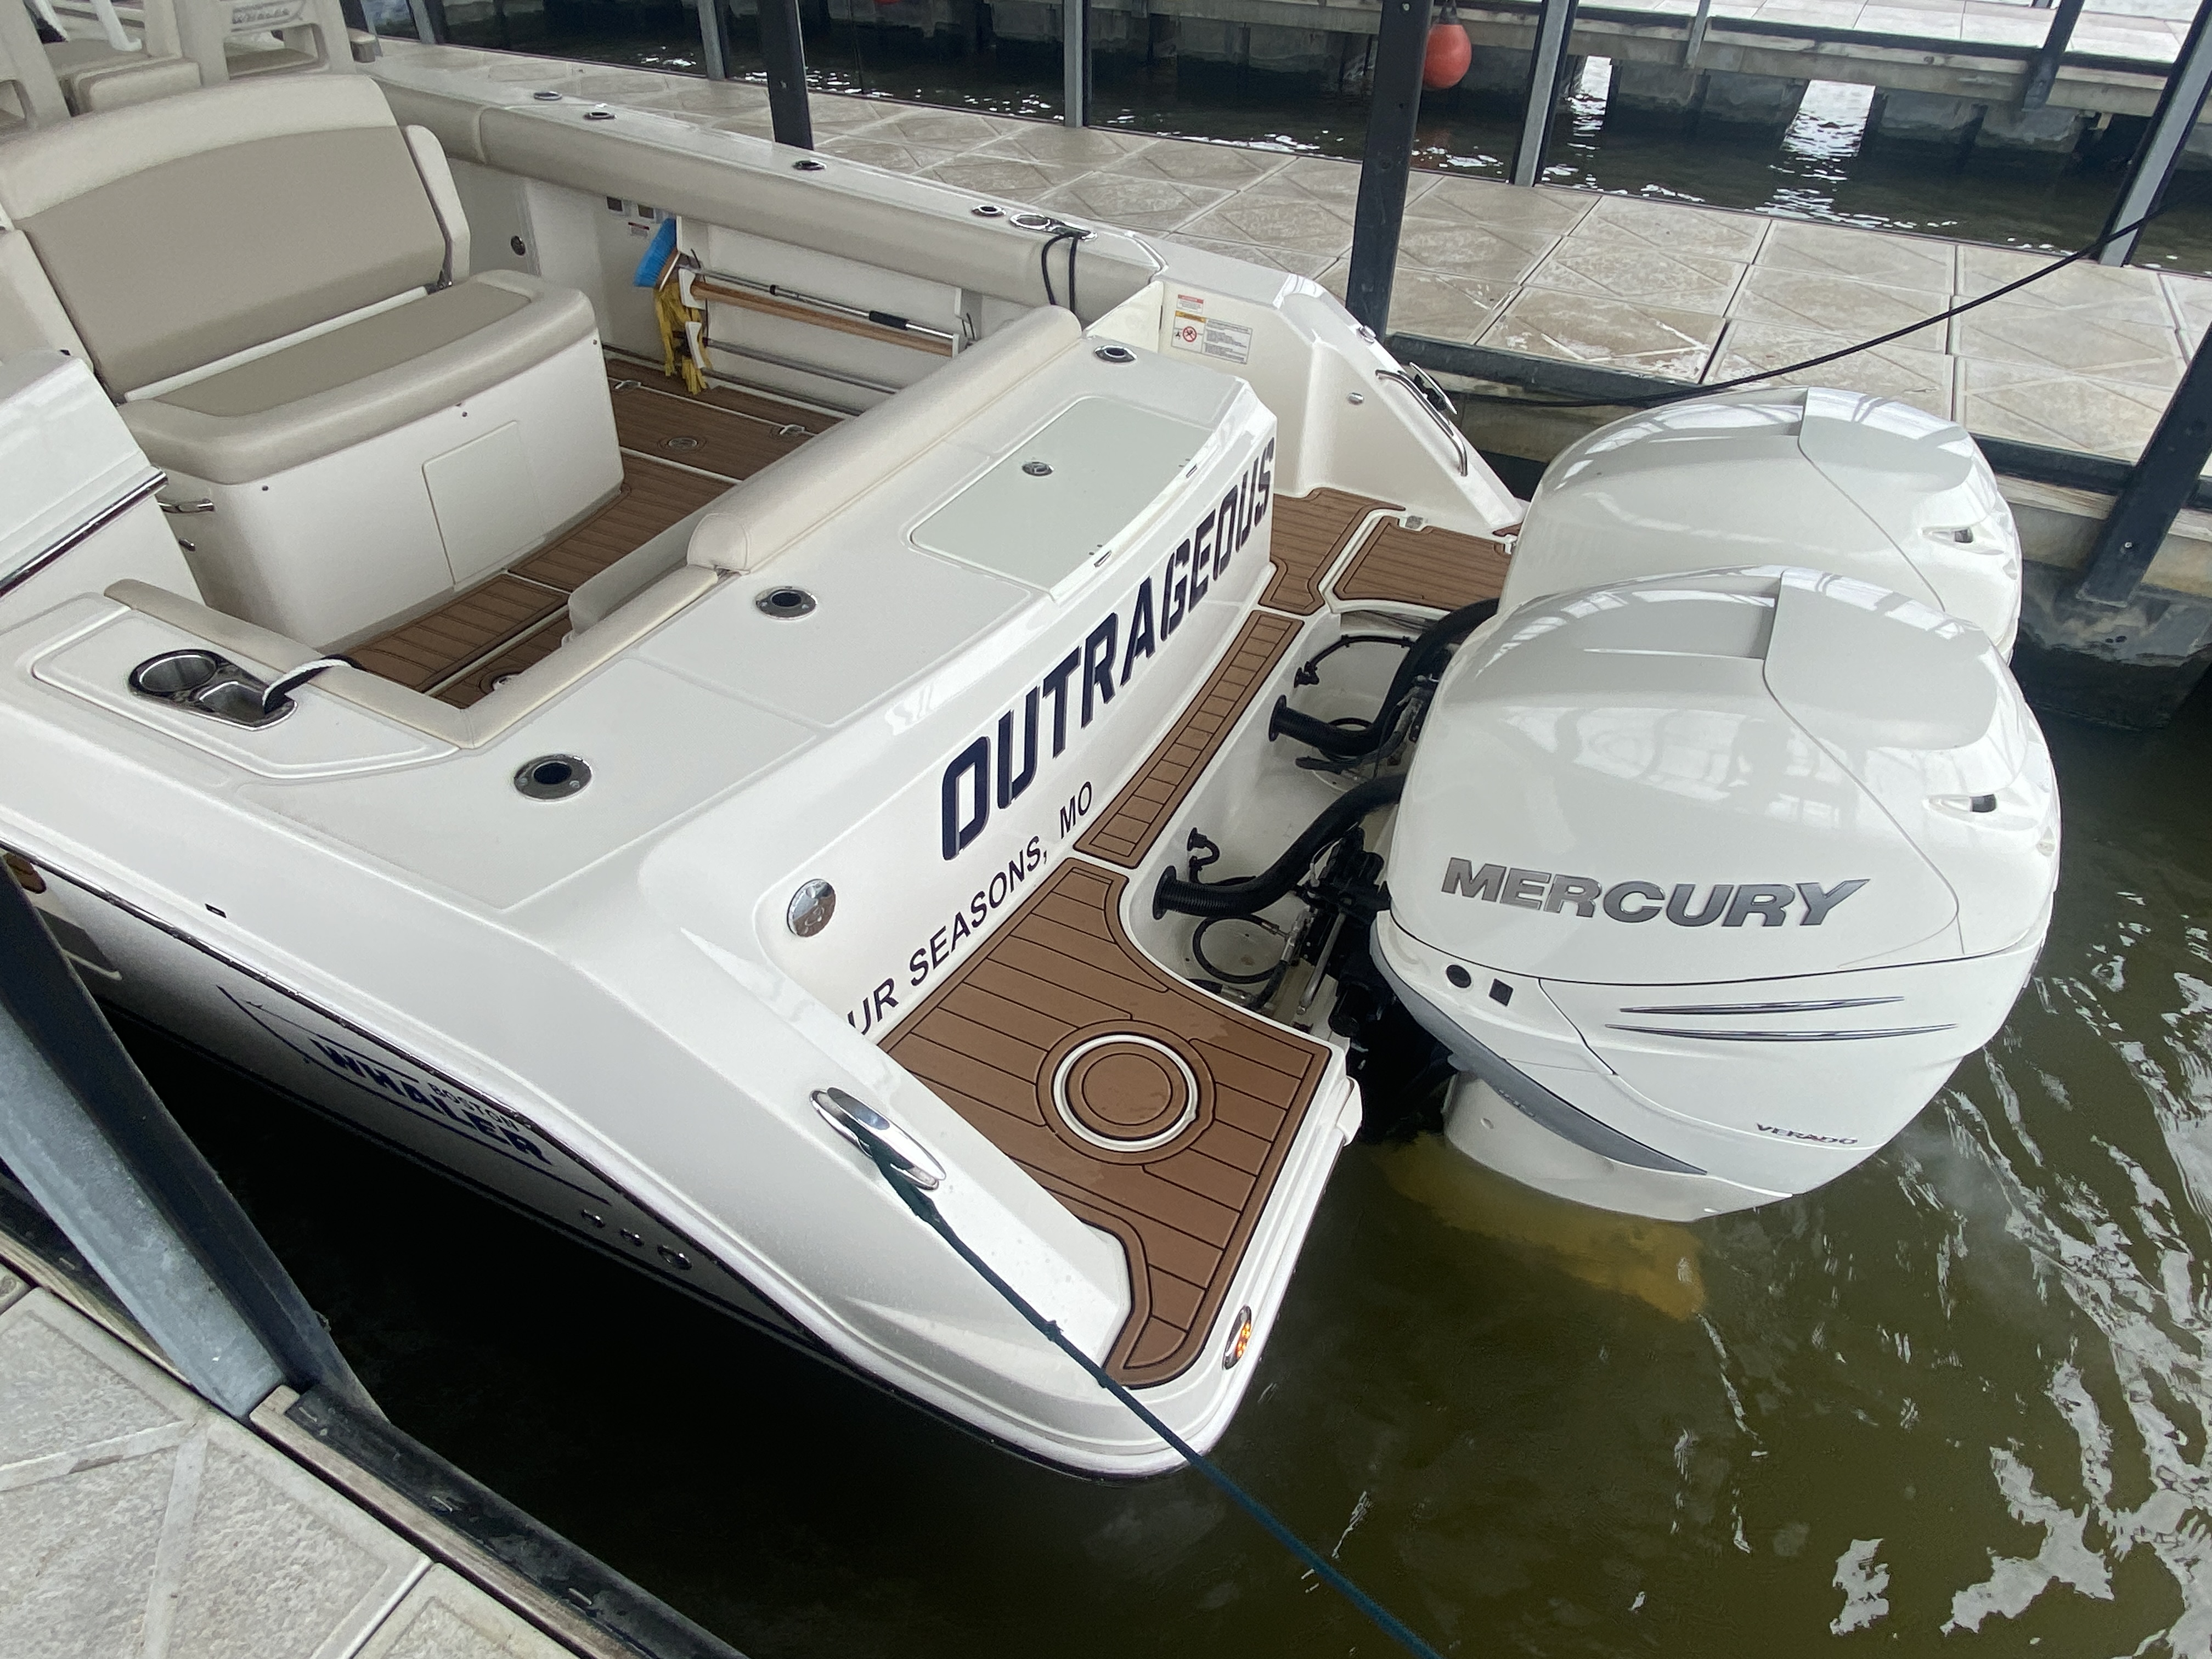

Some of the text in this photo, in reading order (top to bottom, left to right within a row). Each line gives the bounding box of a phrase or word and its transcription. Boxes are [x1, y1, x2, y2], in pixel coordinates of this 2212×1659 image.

[942, 437, 1274, 860] OUTRAGEOUS
[909, 836, 1047, 987] SEASONS,
[1059, 781, 1093, 839] MO
[1441, 857, 1870, 928] MERCURY
[308, 1037, 553, 1166] WHALER
[427, 1082, 520, 1132] BOSTON
[1756, 1122, 1858, 1145] VERADO
